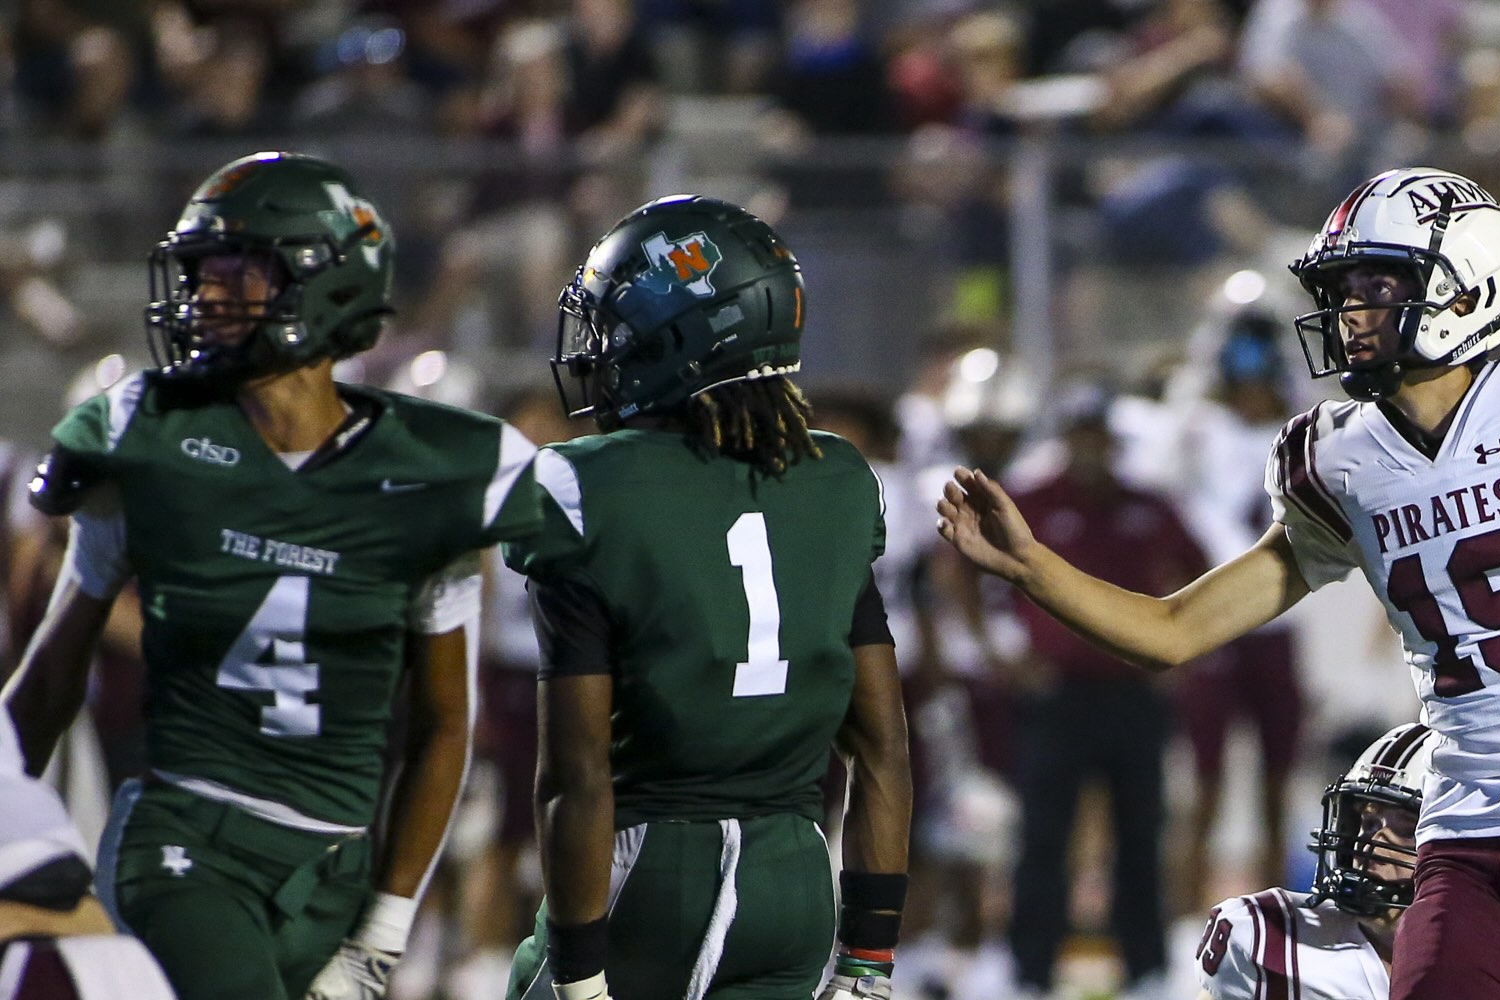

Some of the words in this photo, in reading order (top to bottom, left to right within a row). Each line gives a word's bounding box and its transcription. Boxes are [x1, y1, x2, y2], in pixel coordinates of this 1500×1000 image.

[1452, 333, 1481, 361] schutt
[221, 528, 260, 559] THE
[262, 538, 339, 574] FOREST
[726, 512, 789, 697] 1
[216, 576, 320, 737] 4
